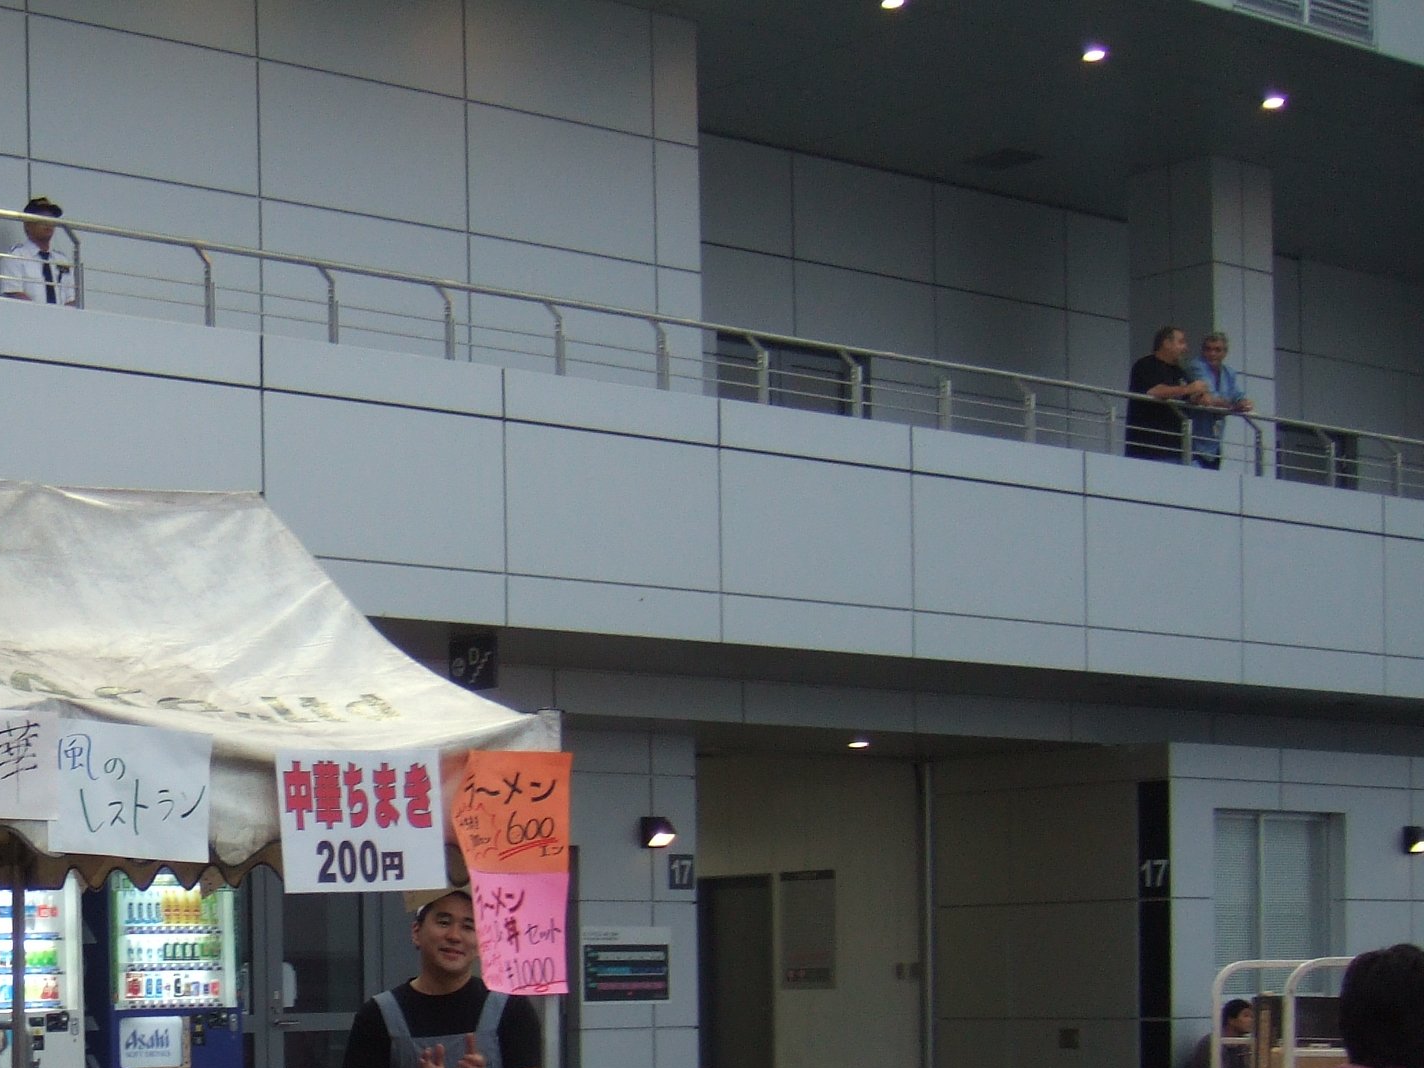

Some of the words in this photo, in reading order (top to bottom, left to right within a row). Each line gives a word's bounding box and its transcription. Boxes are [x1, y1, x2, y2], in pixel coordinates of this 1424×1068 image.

[58, 733, 126, 781] 風の
[79, 779, 206, 836] レストラン
[283, 761, 433, 832] 中華ちまき
[464, 771, 557, 808] ラーメン
[506, 810, 555, 845] 600
[317, 840, 405, 884] 200円
[671, 859, 691, 885] 17
[1141, 859, 1168, 887] 17
[125, 1028, 170, 1050] Asahi
